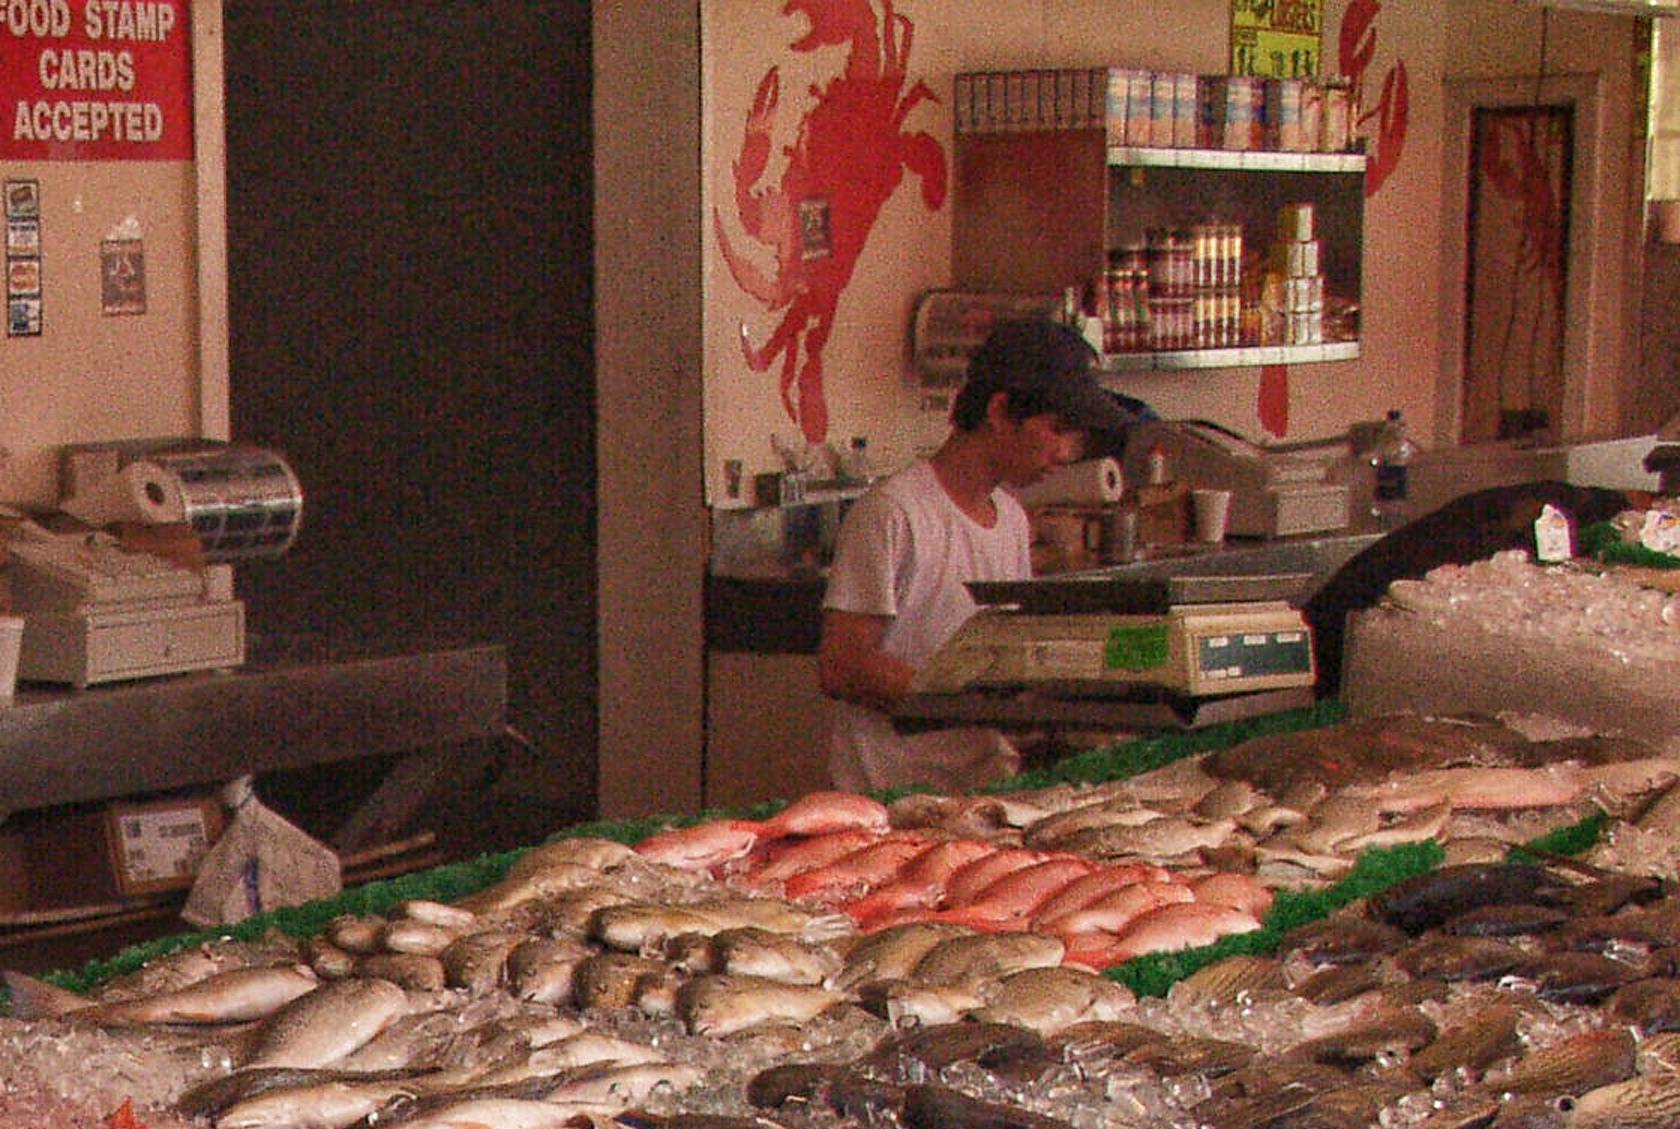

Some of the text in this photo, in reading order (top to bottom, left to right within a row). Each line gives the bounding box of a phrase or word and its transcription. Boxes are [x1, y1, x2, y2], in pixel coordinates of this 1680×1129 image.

[85, 0, 176, 42] STAMP
[39, 49, 136, 91] CARDS
[12, 100, 164, 142] ACCEPTED
